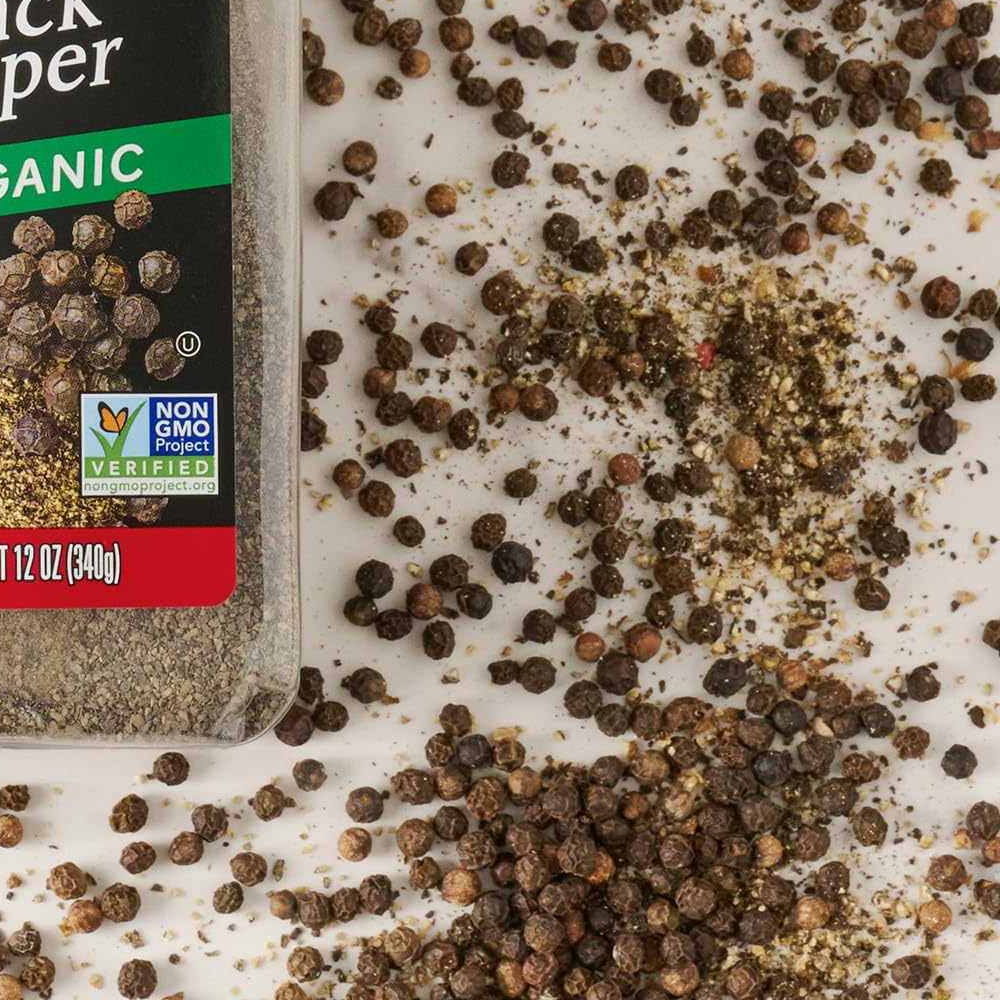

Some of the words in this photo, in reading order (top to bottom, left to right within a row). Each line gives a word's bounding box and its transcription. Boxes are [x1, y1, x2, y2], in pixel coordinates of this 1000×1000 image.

[156, 401, 209, 419] NON
[155, 420, 210, 438] GMO
[156, 438, 210, 455] Project
[91, 460, 209, 476] VERIFIED
[84, 480, 216, 494] nongmoproject.org
[13, 543, 35, 581] 12
[39, 543, 63, 581] OZ
[66, 542, 121, 585] (340g)
